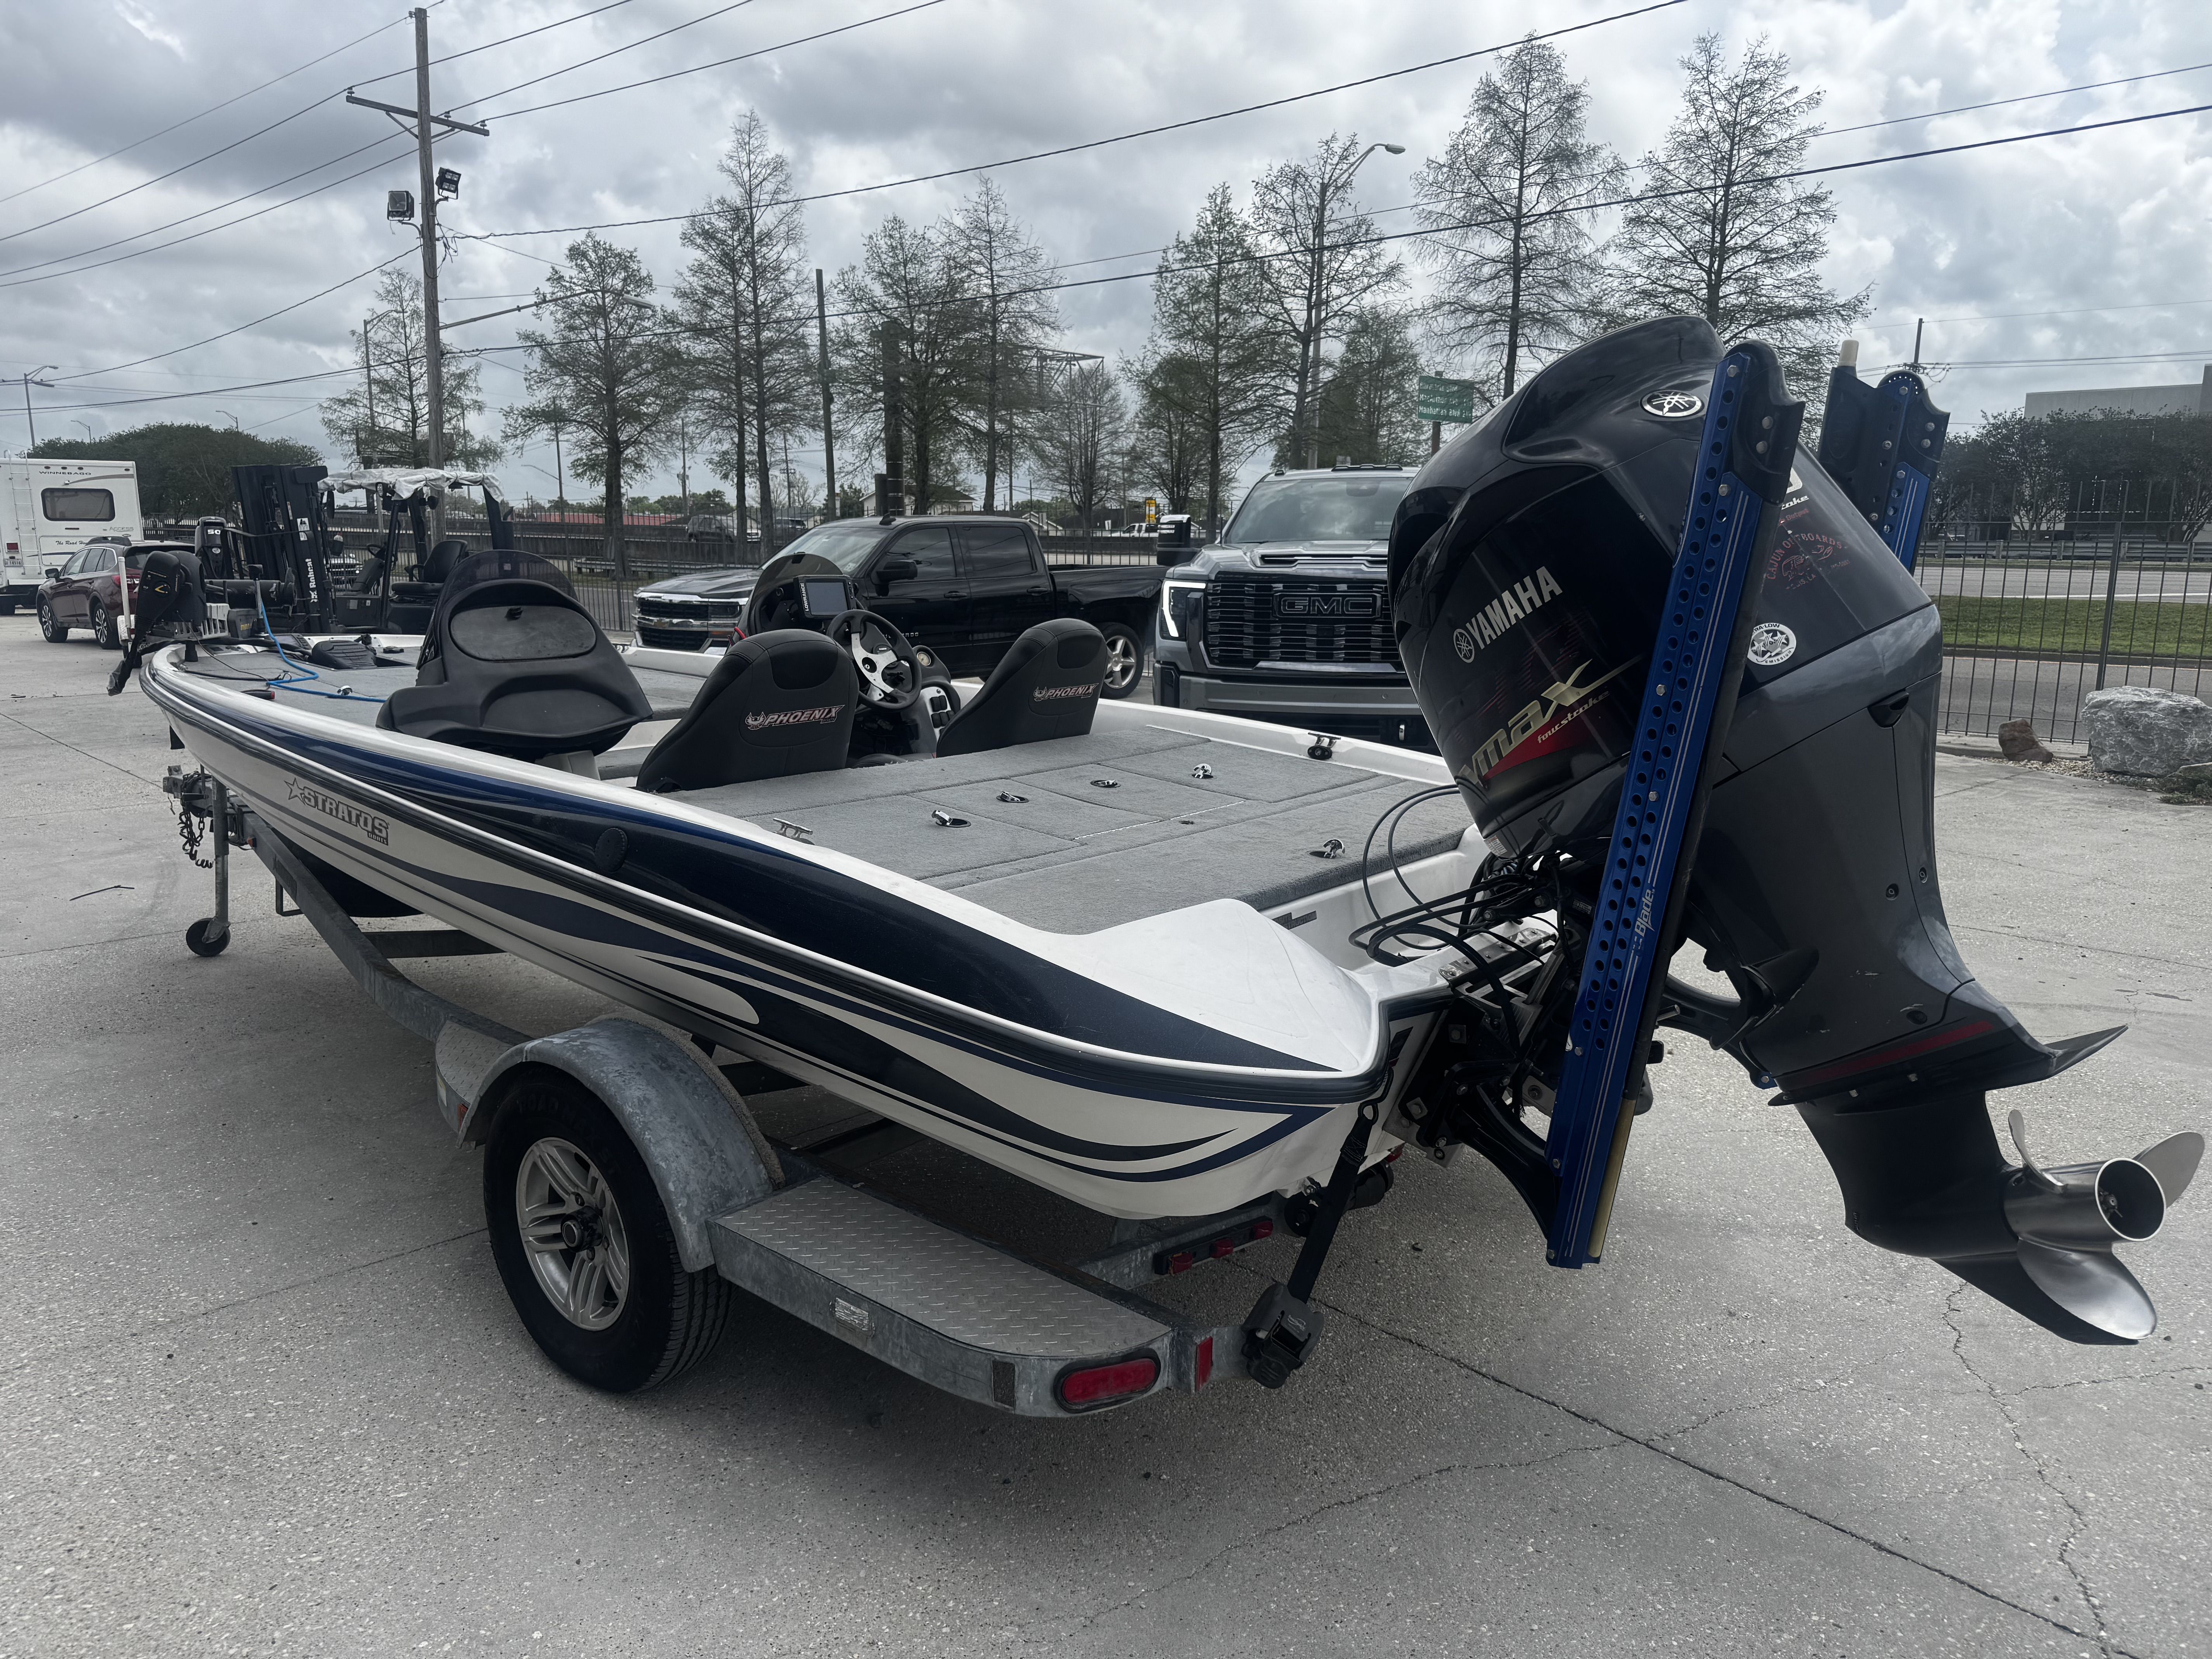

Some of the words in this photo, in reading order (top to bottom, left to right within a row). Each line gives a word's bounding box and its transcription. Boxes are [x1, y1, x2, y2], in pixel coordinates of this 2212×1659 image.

[1419, 406, 1446, 416] Manhattan
[305, 558, 316, 588] Bobcat
[1766, 549, 1785, 579] CAJUN
[800, 582, 809, 611] LOWRANCE
[1281, 597, 1372, 614] GMC
[1465, 566, 1563, 649] YAMAHA
[1765, 650, 1792, 663] EMISSION
[1044, 685, 1096, 699] PHOENIX
[763, 707, 841, 726] PHOENIX
[303, 786, 389, 838] STRATOS
[1634, 889, 1656, 937] Blade
